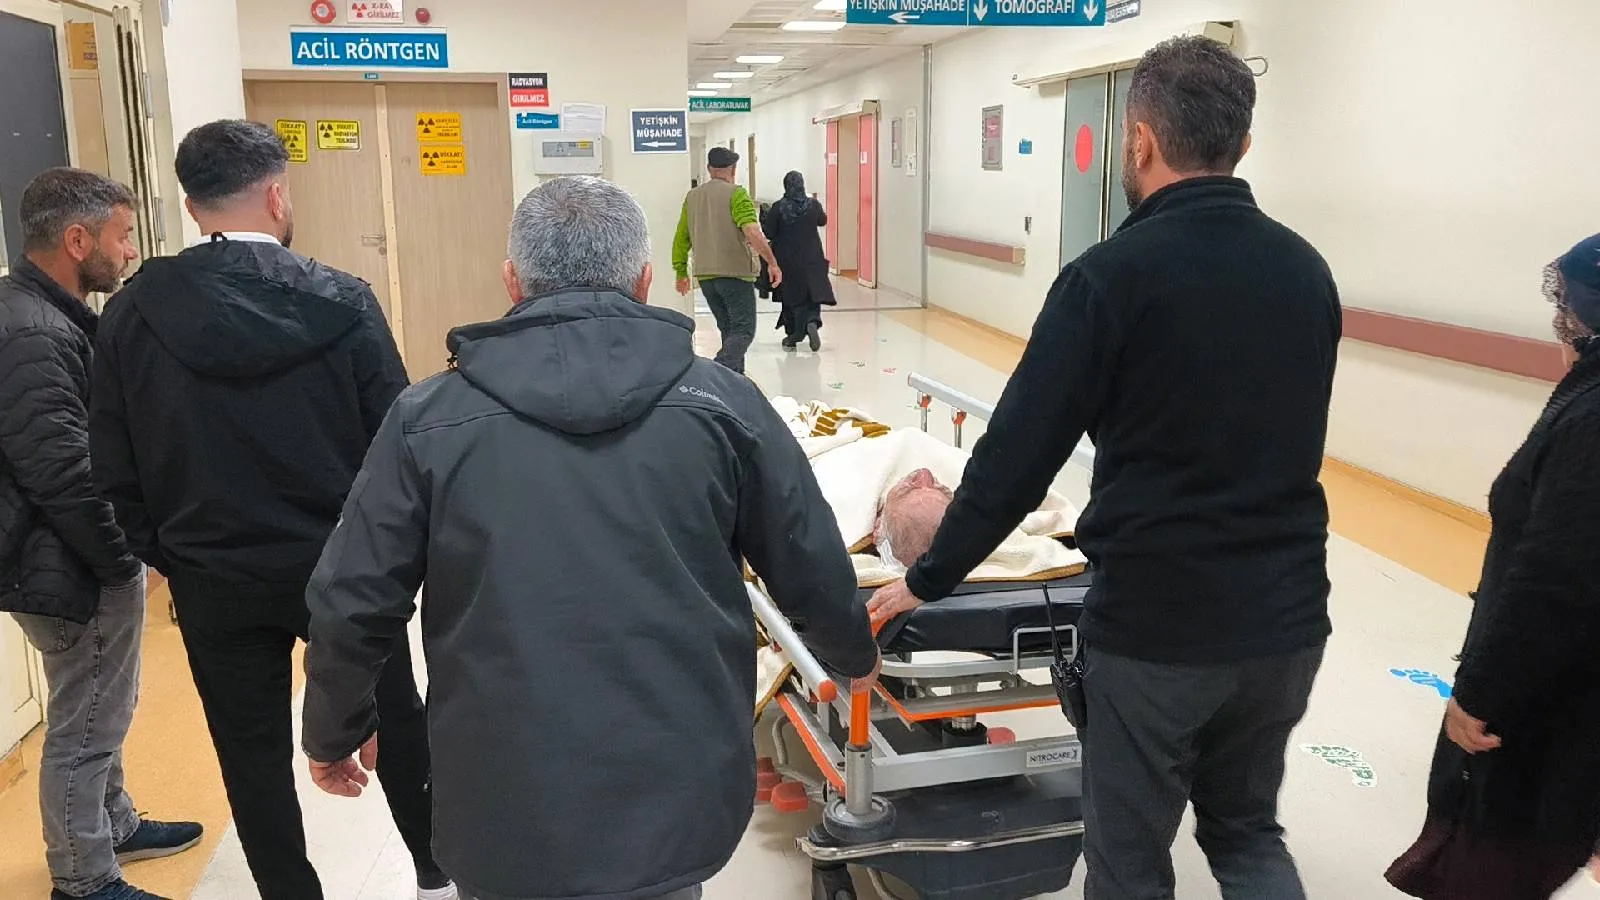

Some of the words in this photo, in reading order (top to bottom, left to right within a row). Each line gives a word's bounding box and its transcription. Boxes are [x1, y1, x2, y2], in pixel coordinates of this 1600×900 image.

[297, 38, 340, 59] ACİL
[345, 38, 440, 60] RÖNTGEN
[640, 116, 678, 127] YETİŞKİN
[636, 127, 683, 138] MÜŞAHADE
